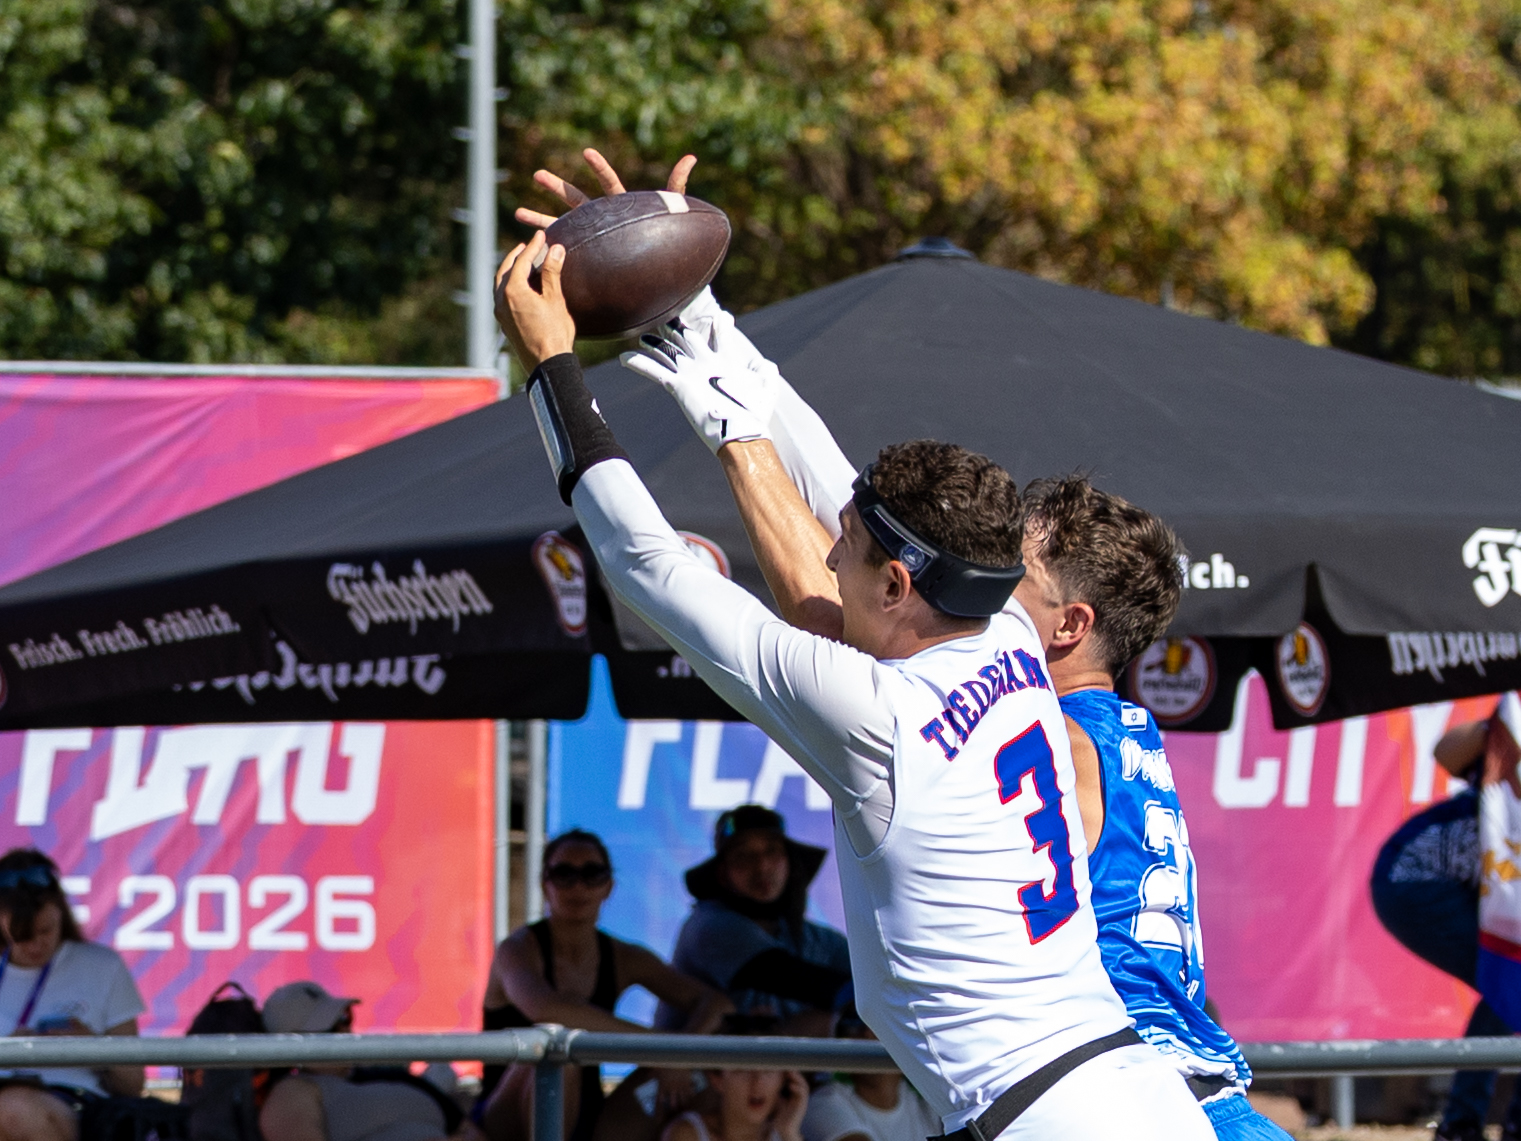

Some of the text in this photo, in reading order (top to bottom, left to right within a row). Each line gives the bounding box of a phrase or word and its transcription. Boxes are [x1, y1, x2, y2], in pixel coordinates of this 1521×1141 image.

[8, 603, 242, 671] Frisch. Frech. Fröhlich.
[616, 718, 834, 811] FLA
[994, 719, 1080, 946] 3
[113, 873, 378, 951] 2026
